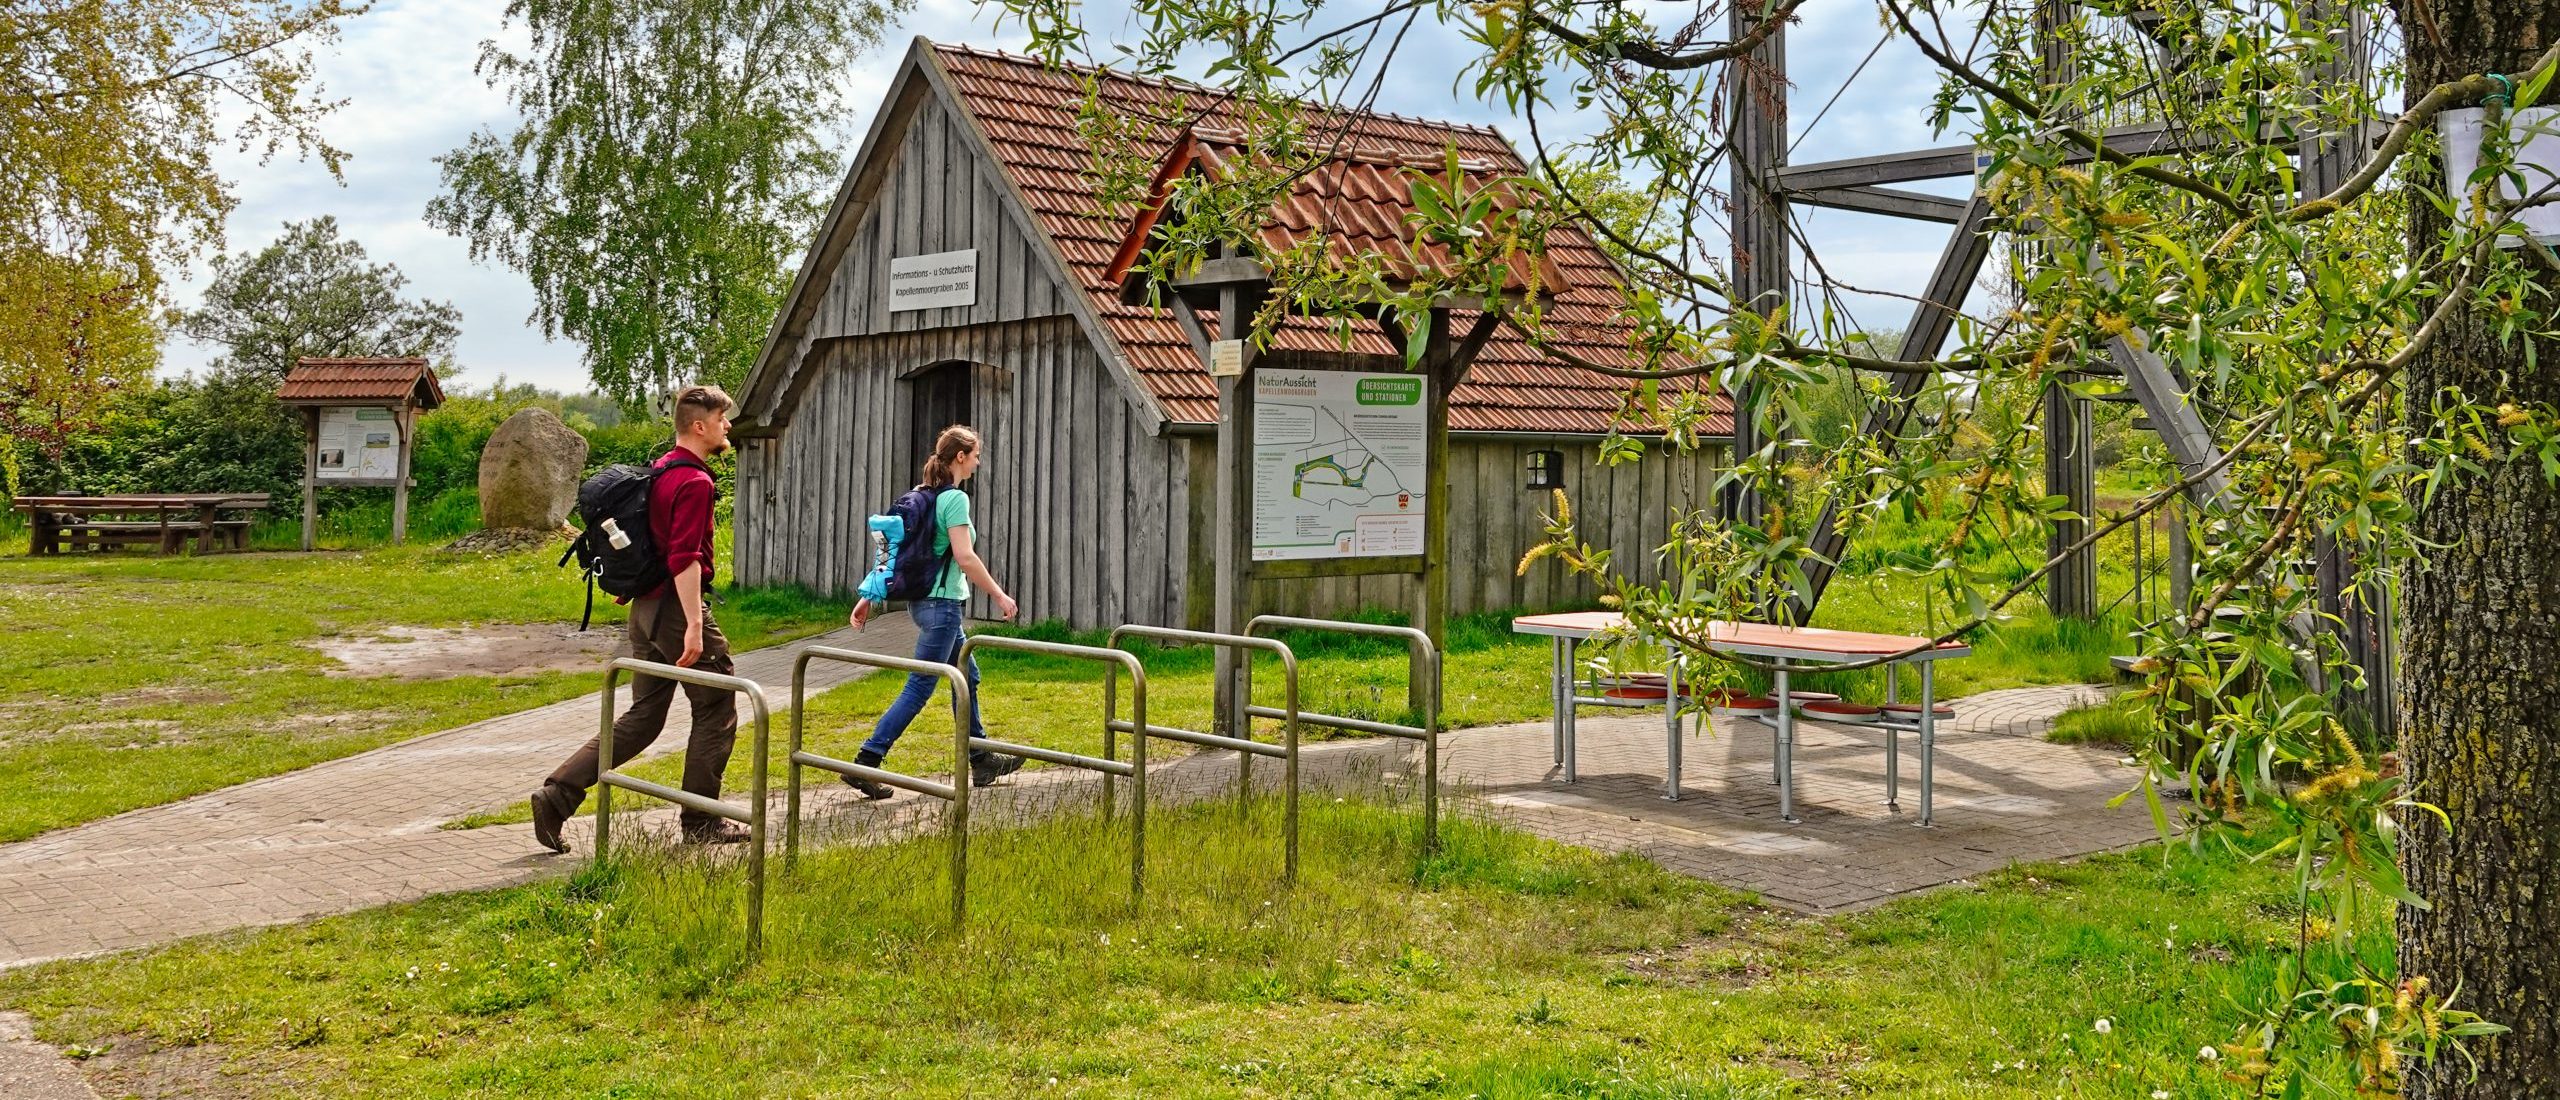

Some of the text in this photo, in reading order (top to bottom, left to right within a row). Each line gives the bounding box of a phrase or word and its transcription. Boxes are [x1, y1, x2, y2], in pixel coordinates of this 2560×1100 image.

[895, 281, 969, 297] Kapellenmoorgraben 2005
[1259, 375, 1317, 387] NaturAussicht
[1361, 380, 1416, 391] ÜBERSICHTSKARTE
[1375, 393, 1407, 401] STATIONEN
